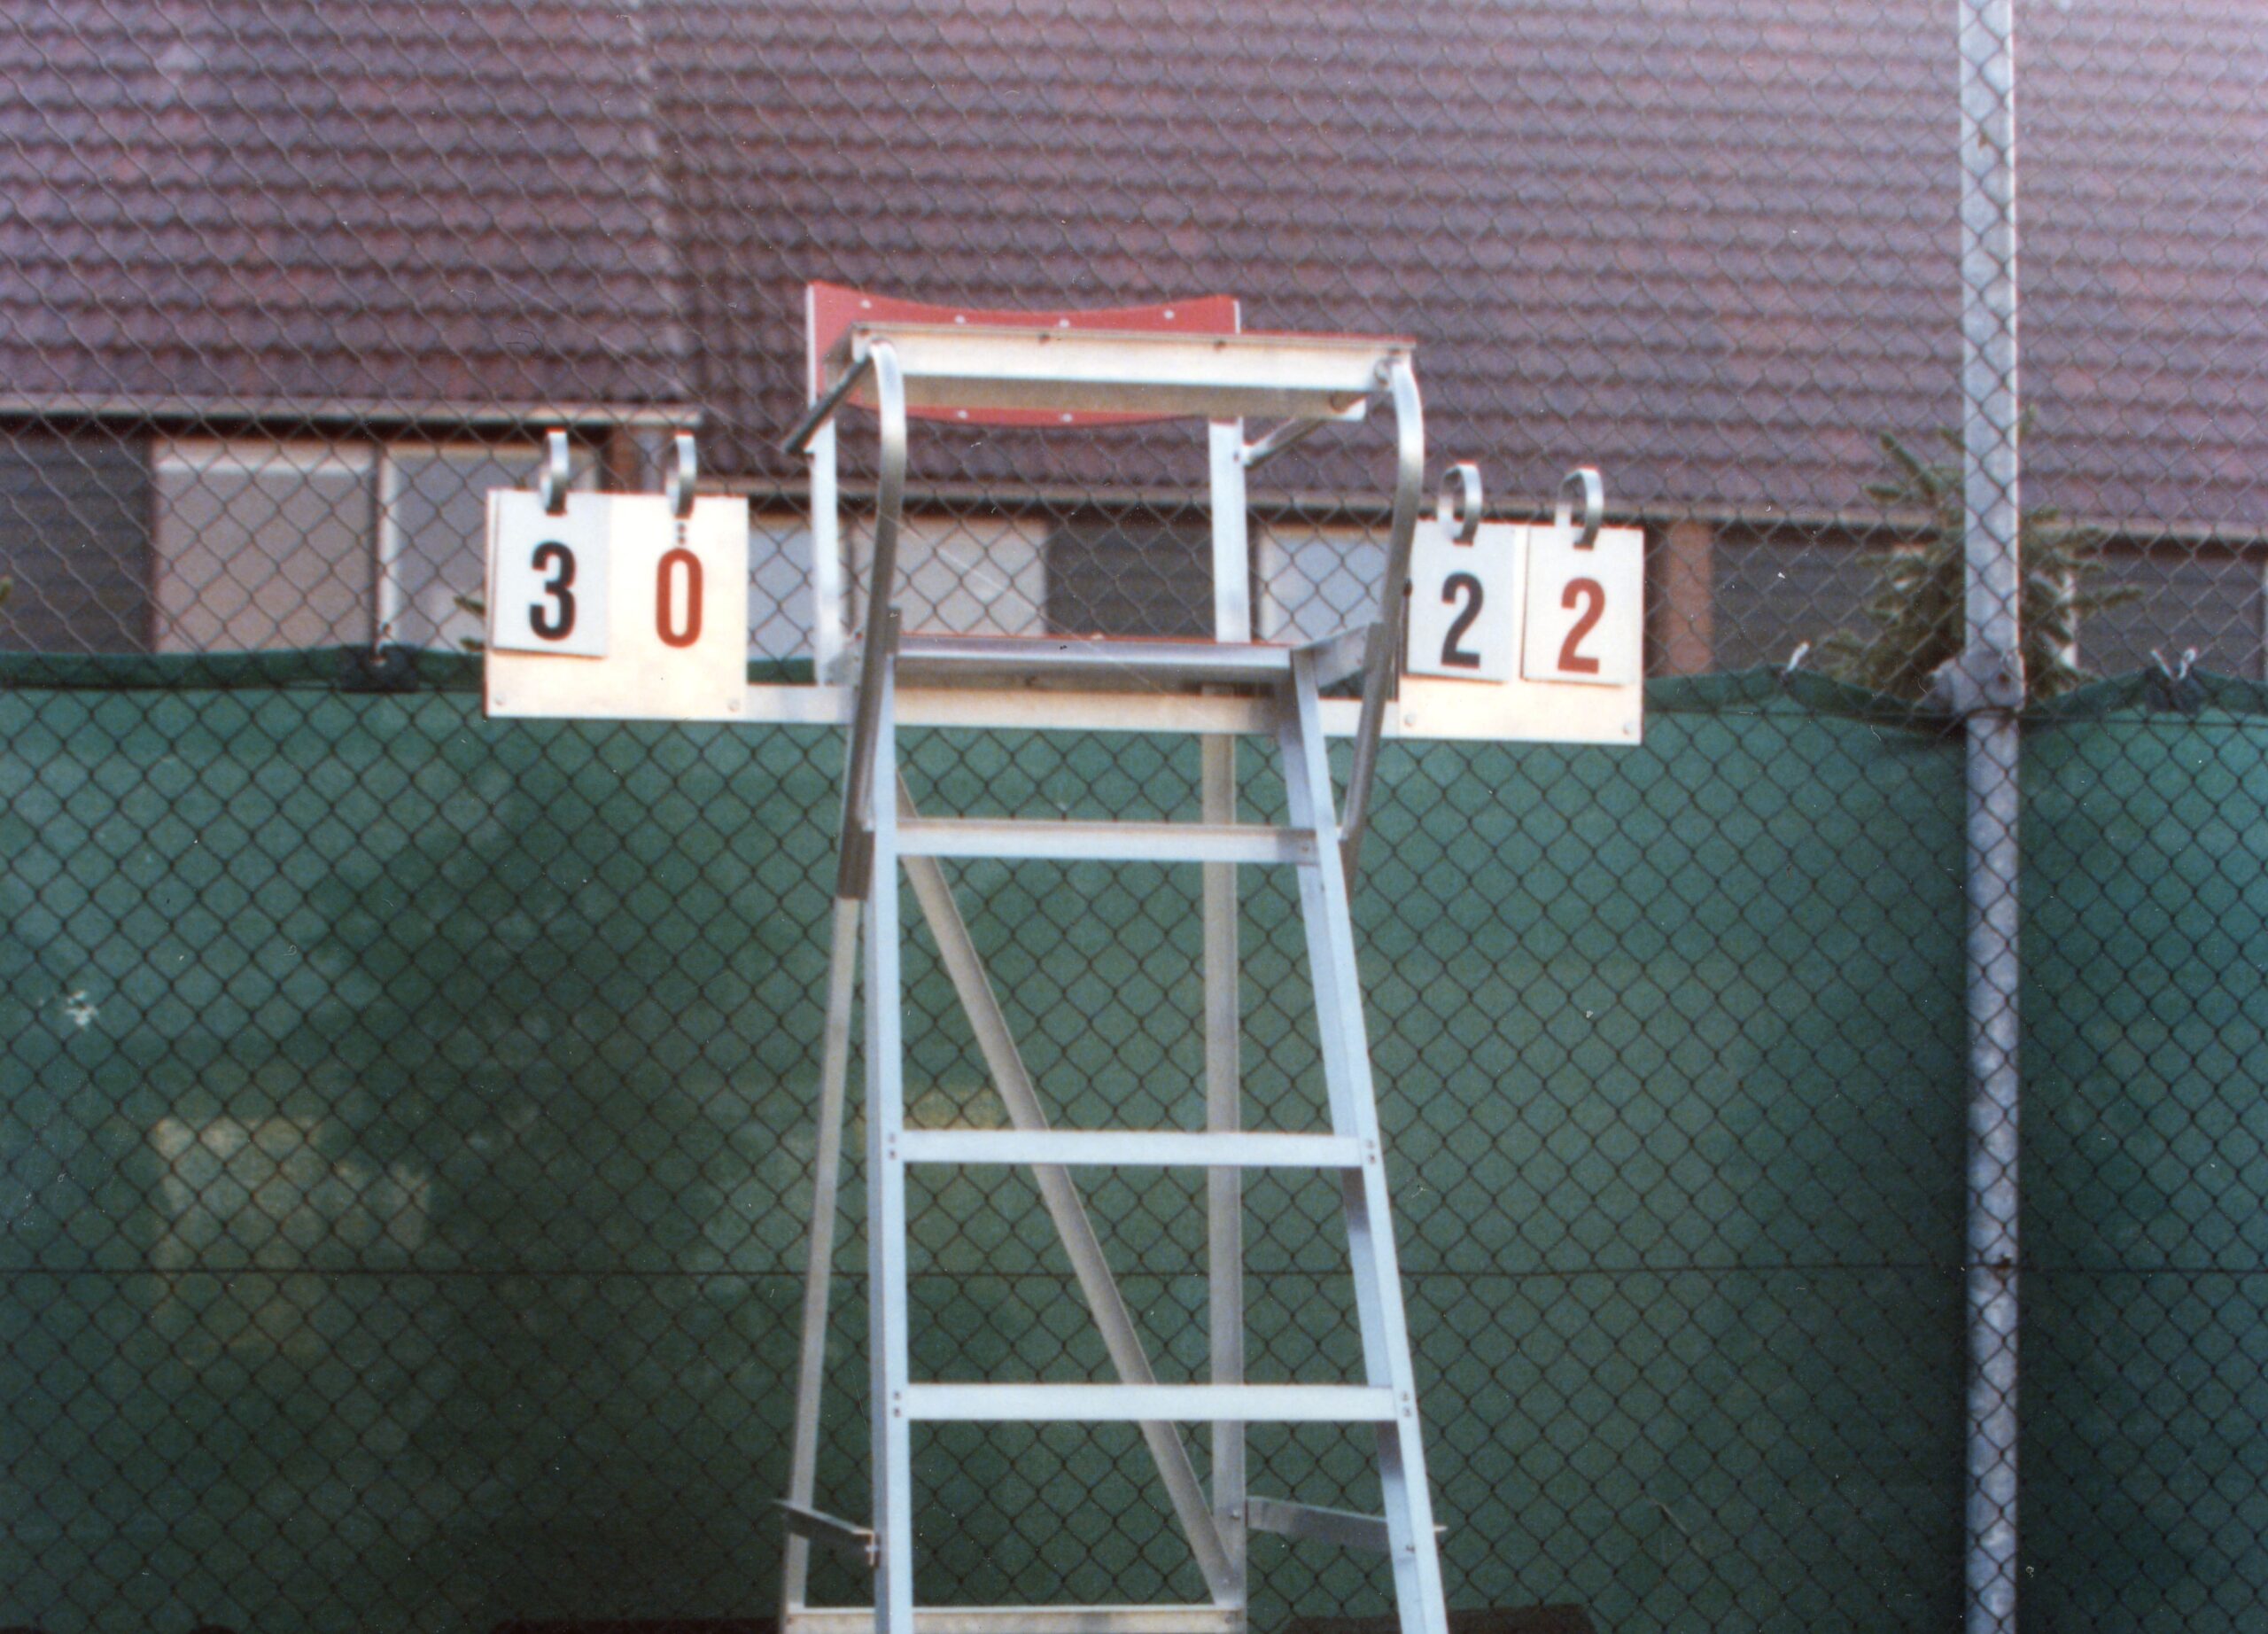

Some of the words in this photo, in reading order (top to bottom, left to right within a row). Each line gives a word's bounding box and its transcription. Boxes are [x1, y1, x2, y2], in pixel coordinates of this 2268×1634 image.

[529, 541, 577, 642] 3
[656, 548, 703, 648] 0
[1441, 571, 1485, 669] 2
[1557, 577, 1606, 674] 2
